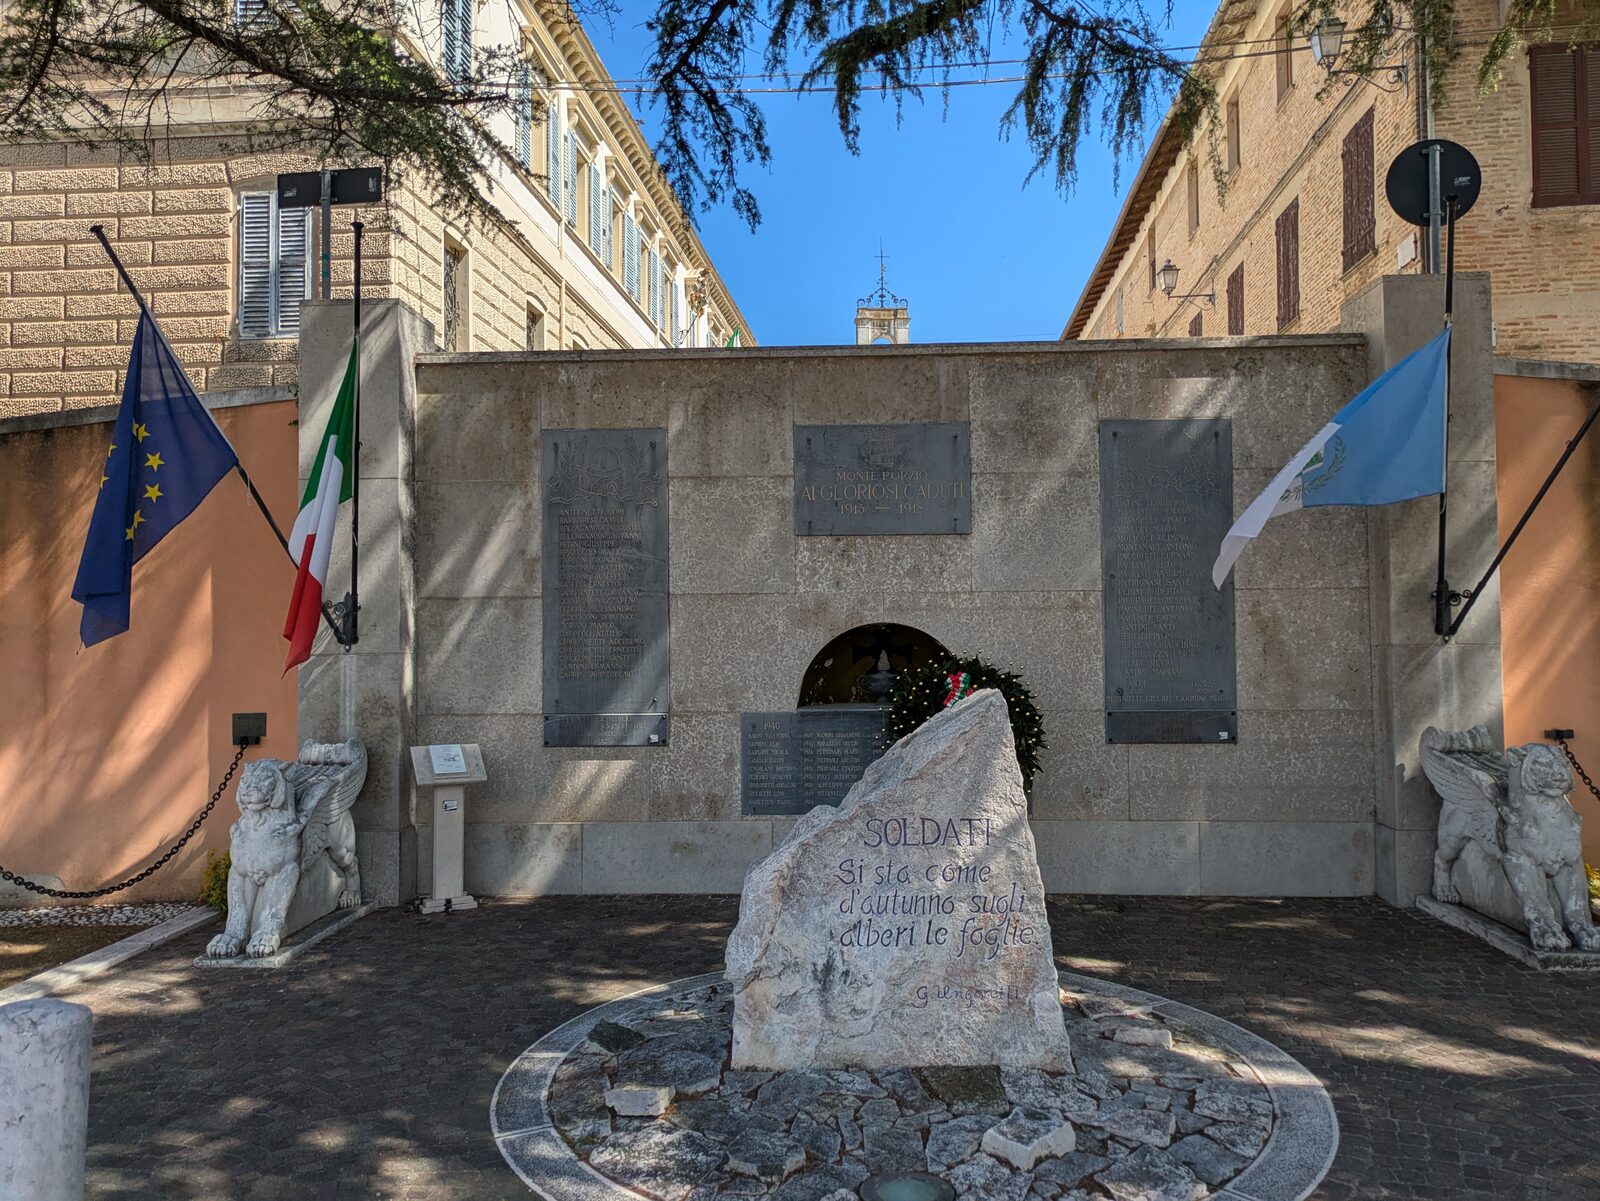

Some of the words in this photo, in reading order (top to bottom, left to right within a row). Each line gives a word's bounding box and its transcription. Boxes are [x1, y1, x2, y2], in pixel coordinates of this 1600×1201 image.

[836, 471, 878, 481] MONTE
[802, 484, 815, 501] AI
[820, 483, 898, 501] GLORIOSI
[903, 482, 964, 500] CADUTI
[863, 817, 992, 848] SOLDATI
[835, 858, 864, 885] Si
[874, 859, 910, 885] sta
[926, 862, 992, 884] come
[840, 888, 955, 916] d'autunno
[968, 882, 1027, 926] sugli
[840, 919, 915, 948] alberi
[926, 921, 948, 946] le
